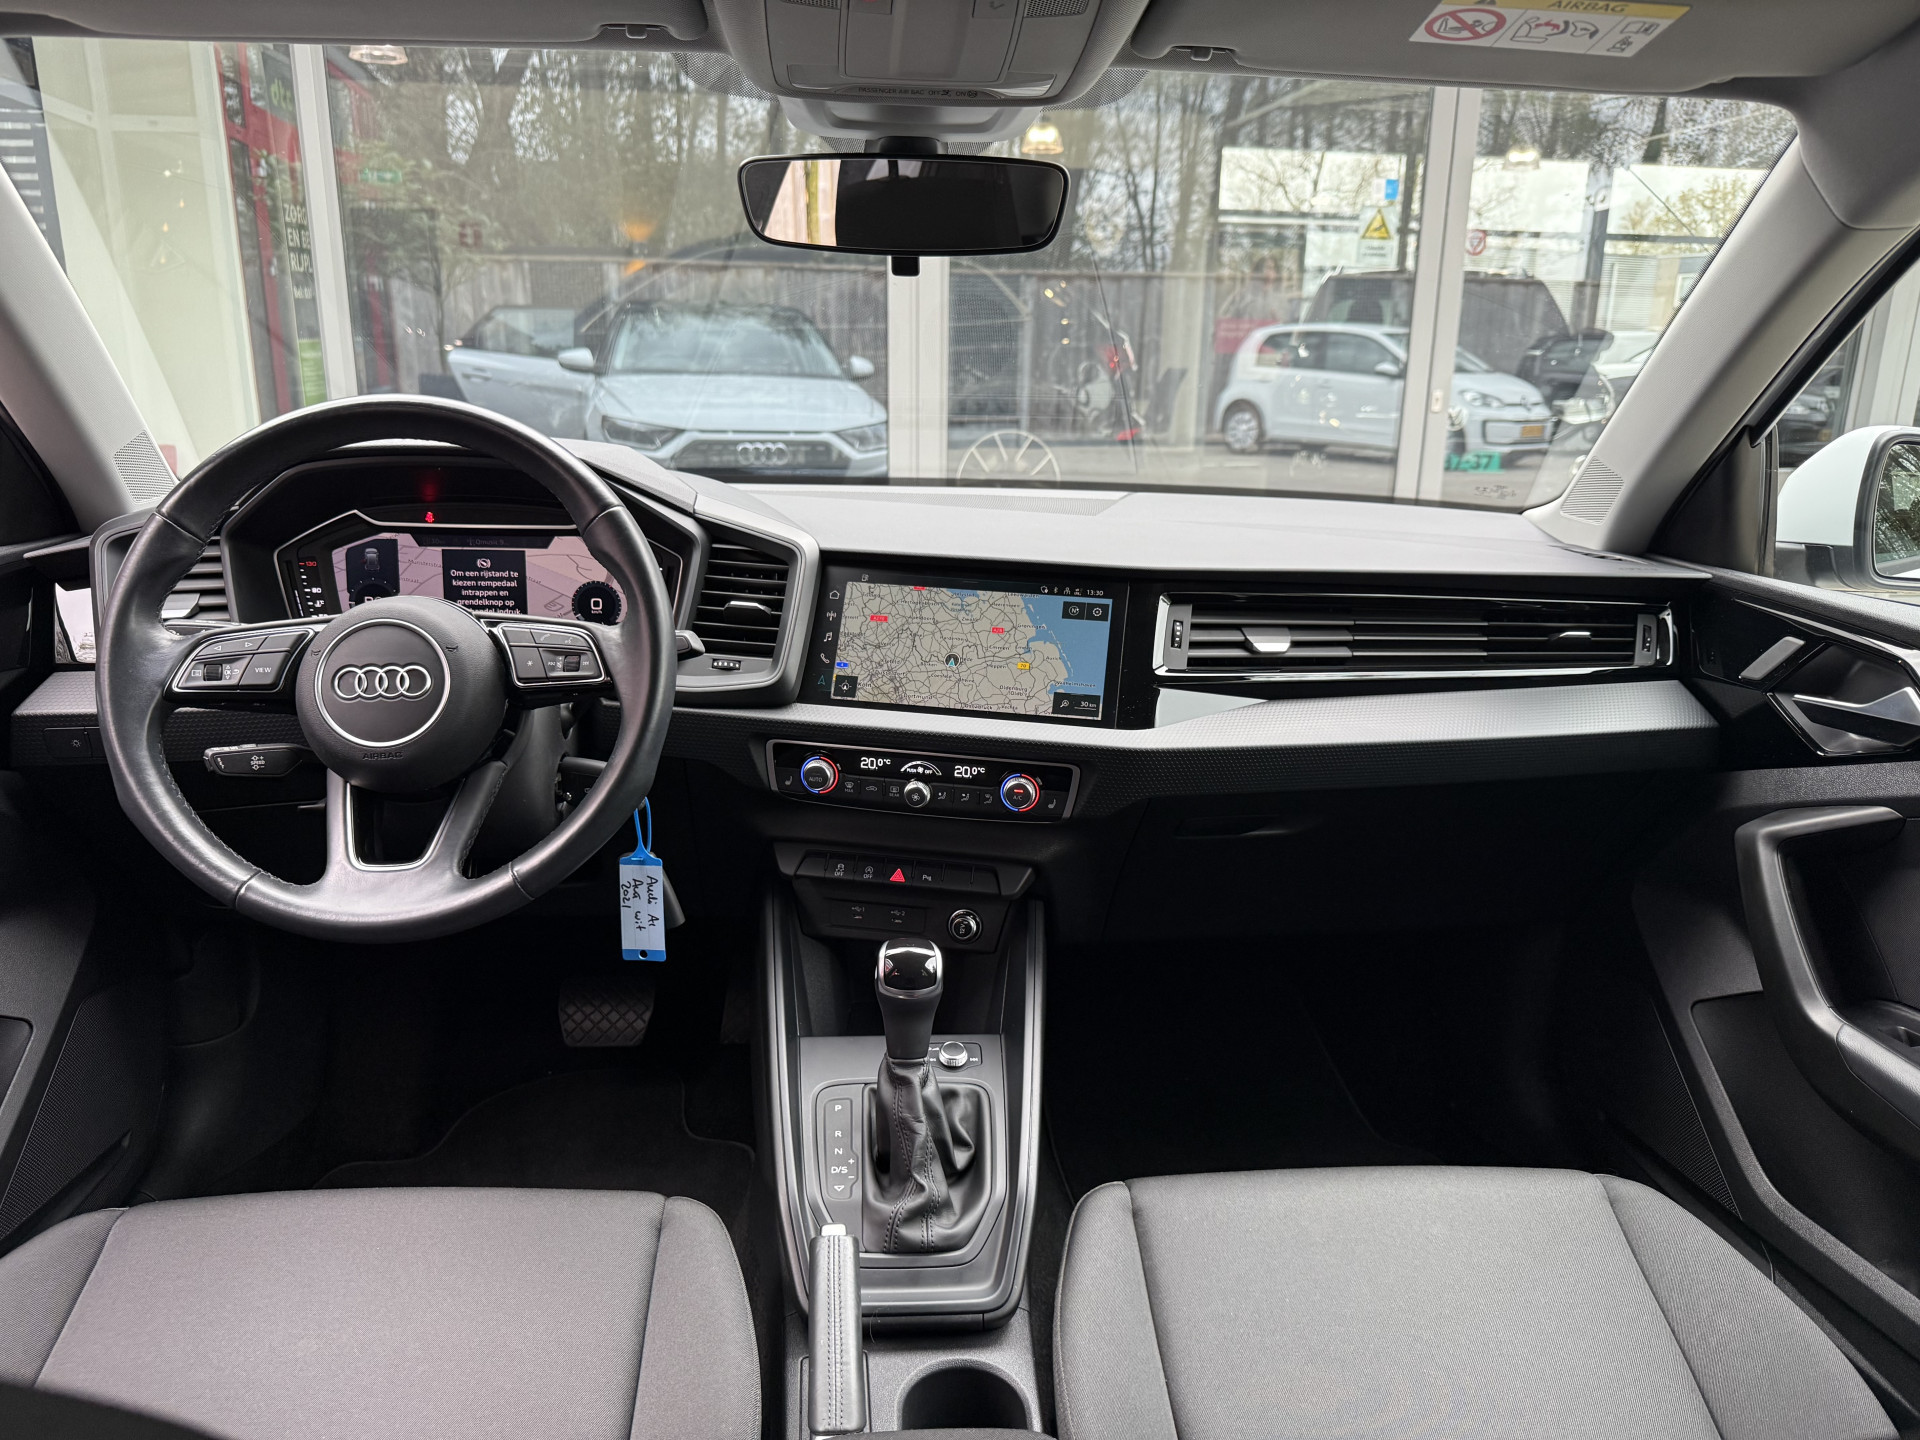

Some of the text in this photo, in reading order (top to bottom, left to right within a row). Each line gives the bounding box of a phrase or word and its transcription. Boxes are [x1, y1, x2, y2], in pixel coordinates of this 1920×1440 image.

[1547, 0, 1629, 13] AIRBAG
[858, 86, 896, 95] PASSENGER
[287, 227, 300, 248] EN
[450, 569, 464, 577] Om
[481, 570, 509, 579] rijstand
[510, 570, 519, 578] te
[452, 579, 518, 589] kiezen rempedaal
[462, 589, 498, 598] intrappen
[457, 599, 515, 608] grendelknop op
[590, 598, 603, 610] 0
[362, 751, 404, 760] AIRBAG
[621, 881, 631, 908] 2021
[647, 875, 658, 905] Audi
[634, 910, 646, 931] wit
[834, 1104, 842, 1112] P
[831, 1166, 848, 1174] D/S
